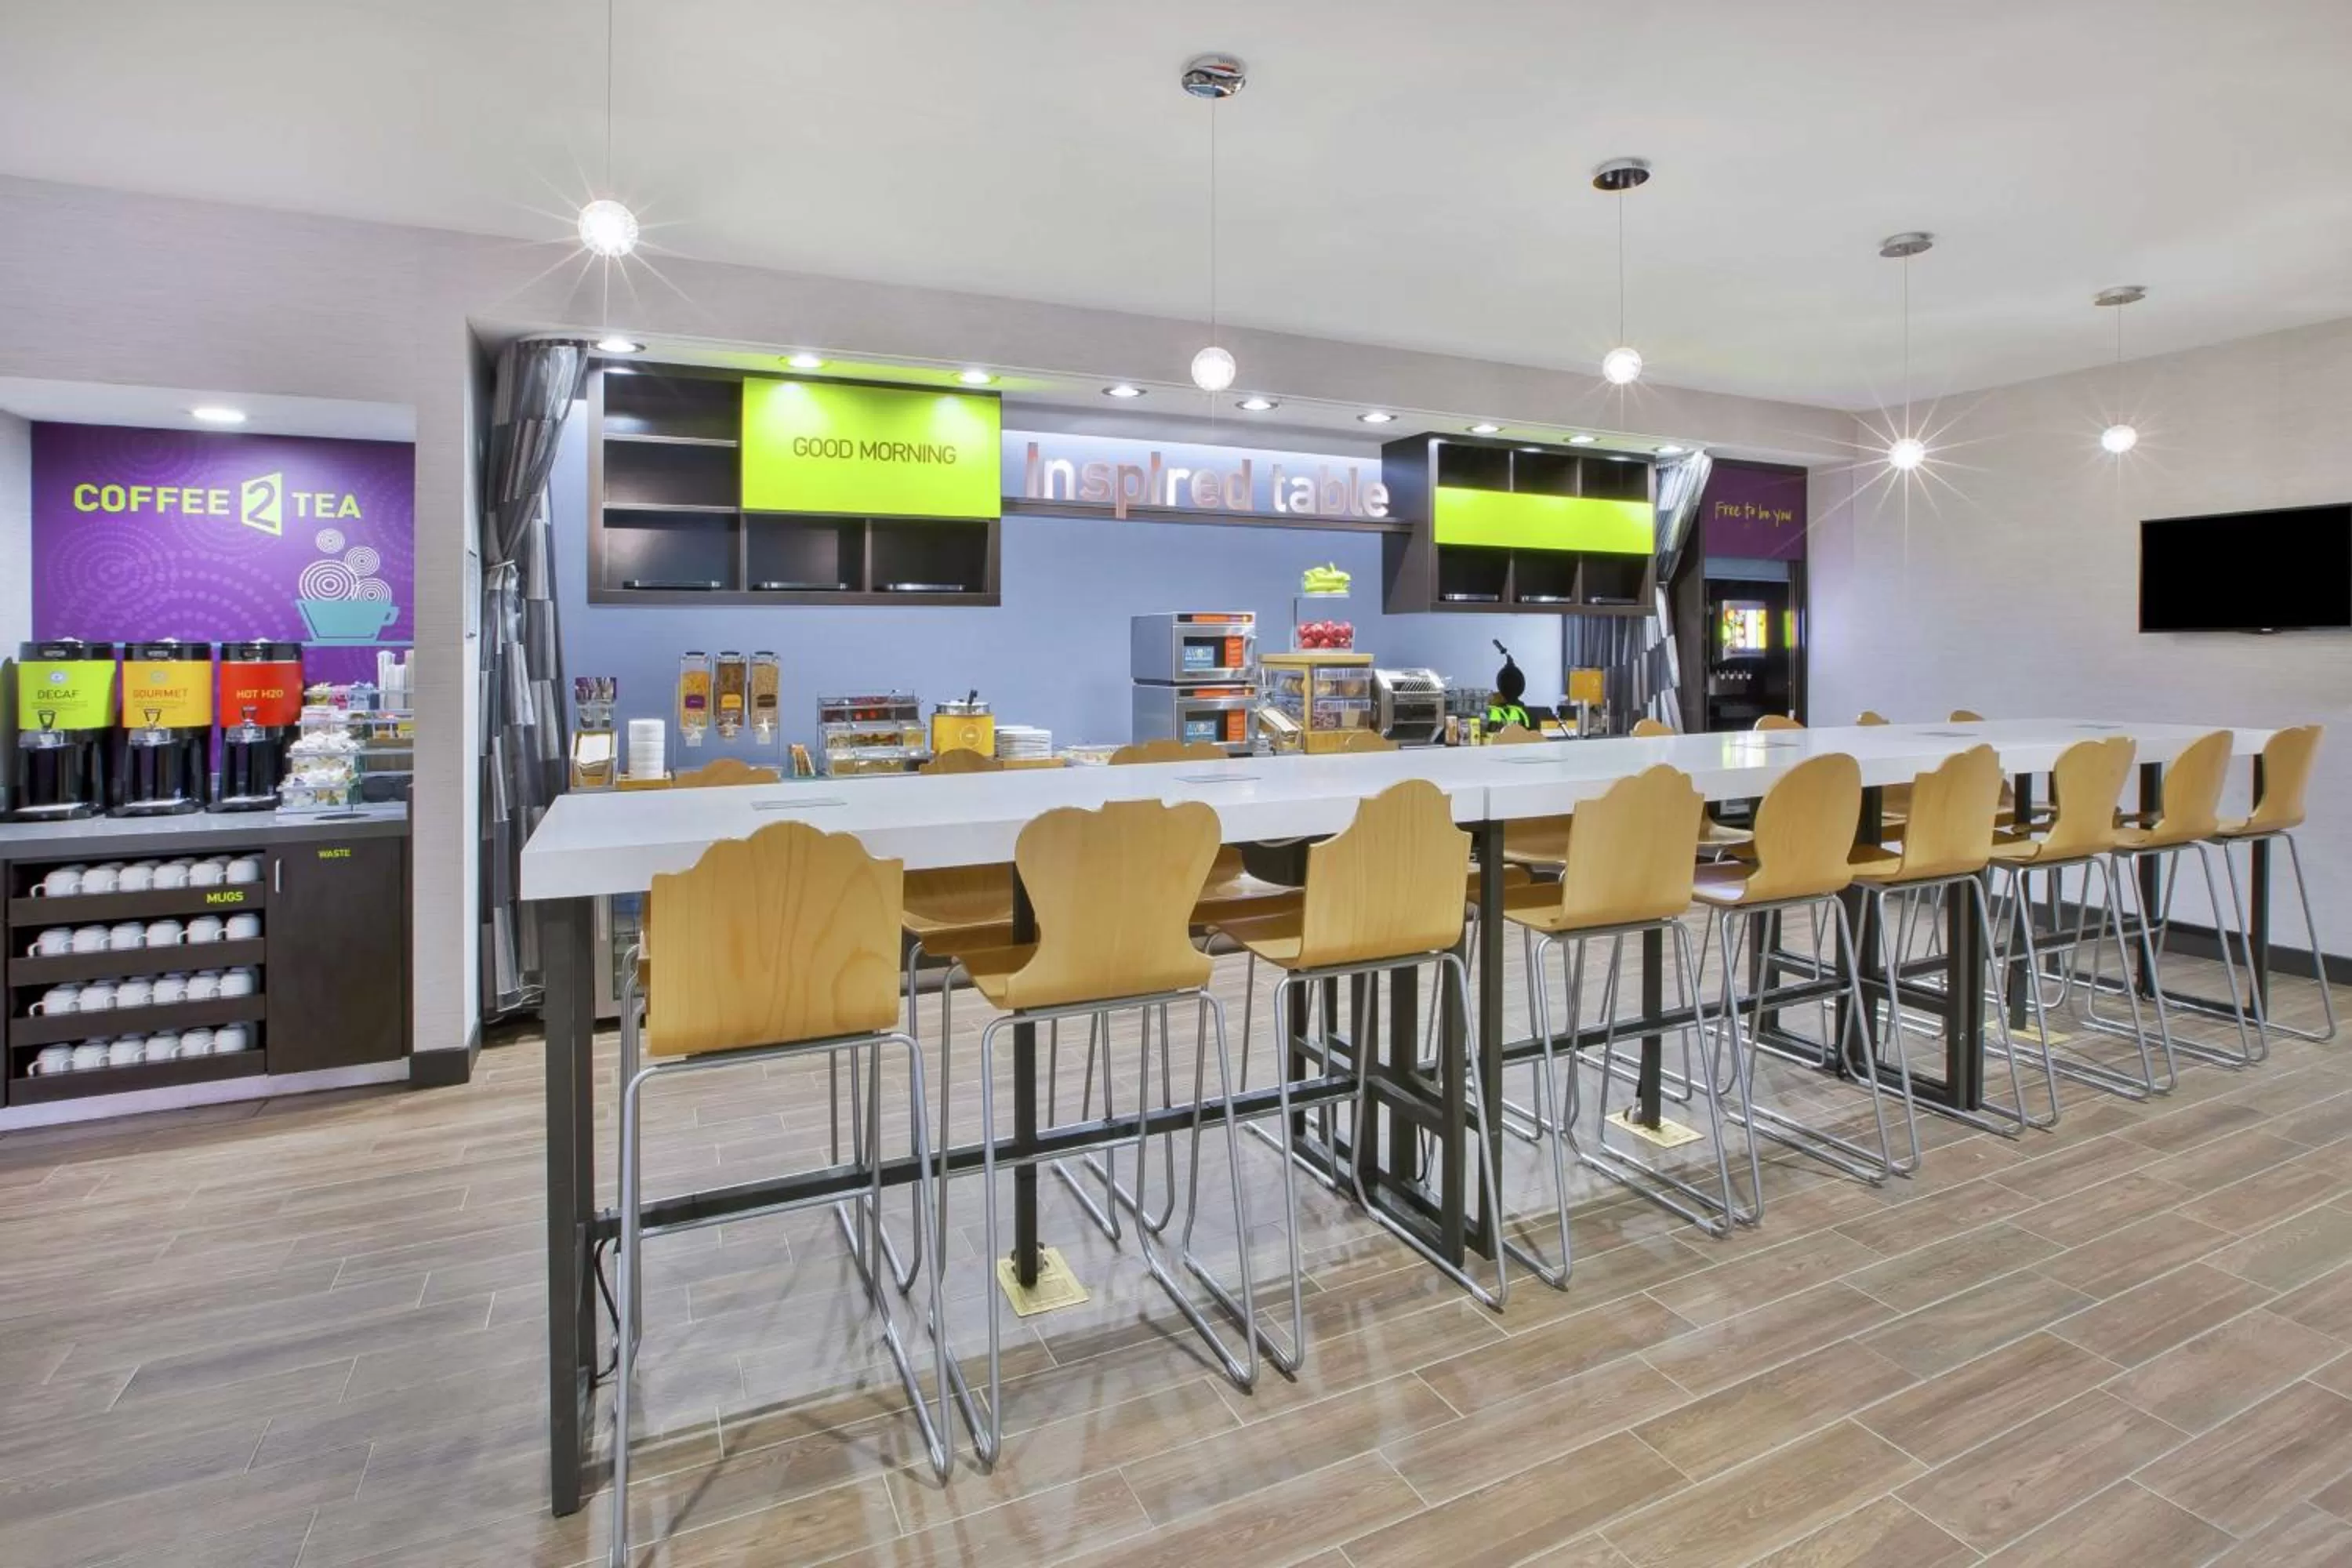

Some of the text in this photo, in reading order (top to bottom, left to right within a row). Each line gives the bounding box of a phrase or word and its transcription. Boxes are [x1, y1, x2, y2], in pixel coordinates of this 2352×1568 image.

[793, 436, 957, 465] GOOD MORNING
[1272, 463, 1391, 517] table
[74, 481, 362, 529] COFFEE 2 TEA
[1715, 501, 1791, 528] Free to be you
[38, 689, 81, 700] DECAF
[133, 688, 188, 699] GOURMET
[236, 689, 258, 699] HOT
[318, 849, 351, 859] WASTE
[206, 891, 245, 904] MUGS
